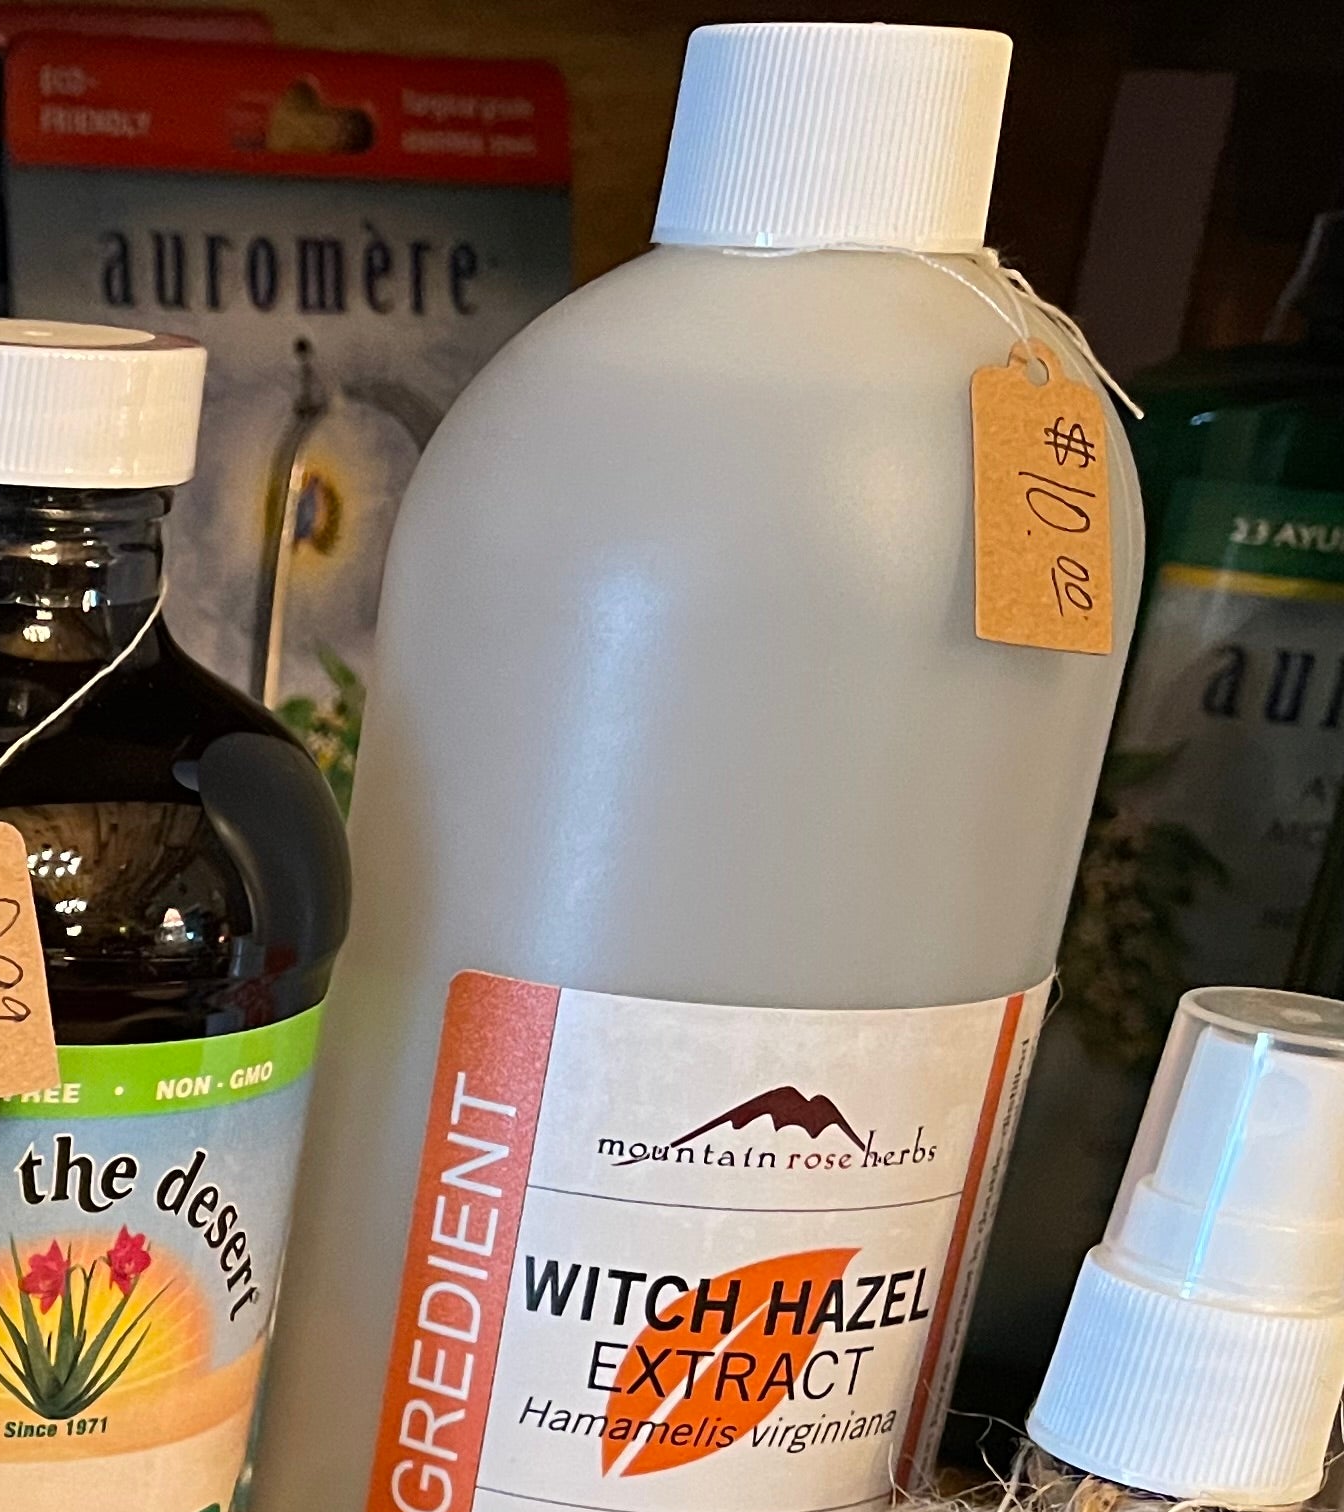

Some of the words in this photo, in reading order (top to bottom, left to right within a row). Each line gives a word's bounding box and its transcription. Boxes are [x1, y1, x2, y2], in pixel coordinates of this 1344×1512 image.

[100, 221, 480, 316] auromère
[597, 1133, 777, 1169] mountain
[786, 1144, 853, 1171] rose
[861, 1126, 938, 1170] herbs
[18, 1135, 139, 1214] the
[156, 1149, 261, 1322] desert
[524, 1254, 742, 1335] WITCH
[763, 1266, 932, 1337] HAZEL
[587, 1341, 876, 1403] EXTRACT
[3, 1419, 57, 1439] Since
[65, 1416, 109, 1437] 1971
[518, 1395, 739, 1450] Hamamelis
[750, 1405, 899, 1455] virginiana
